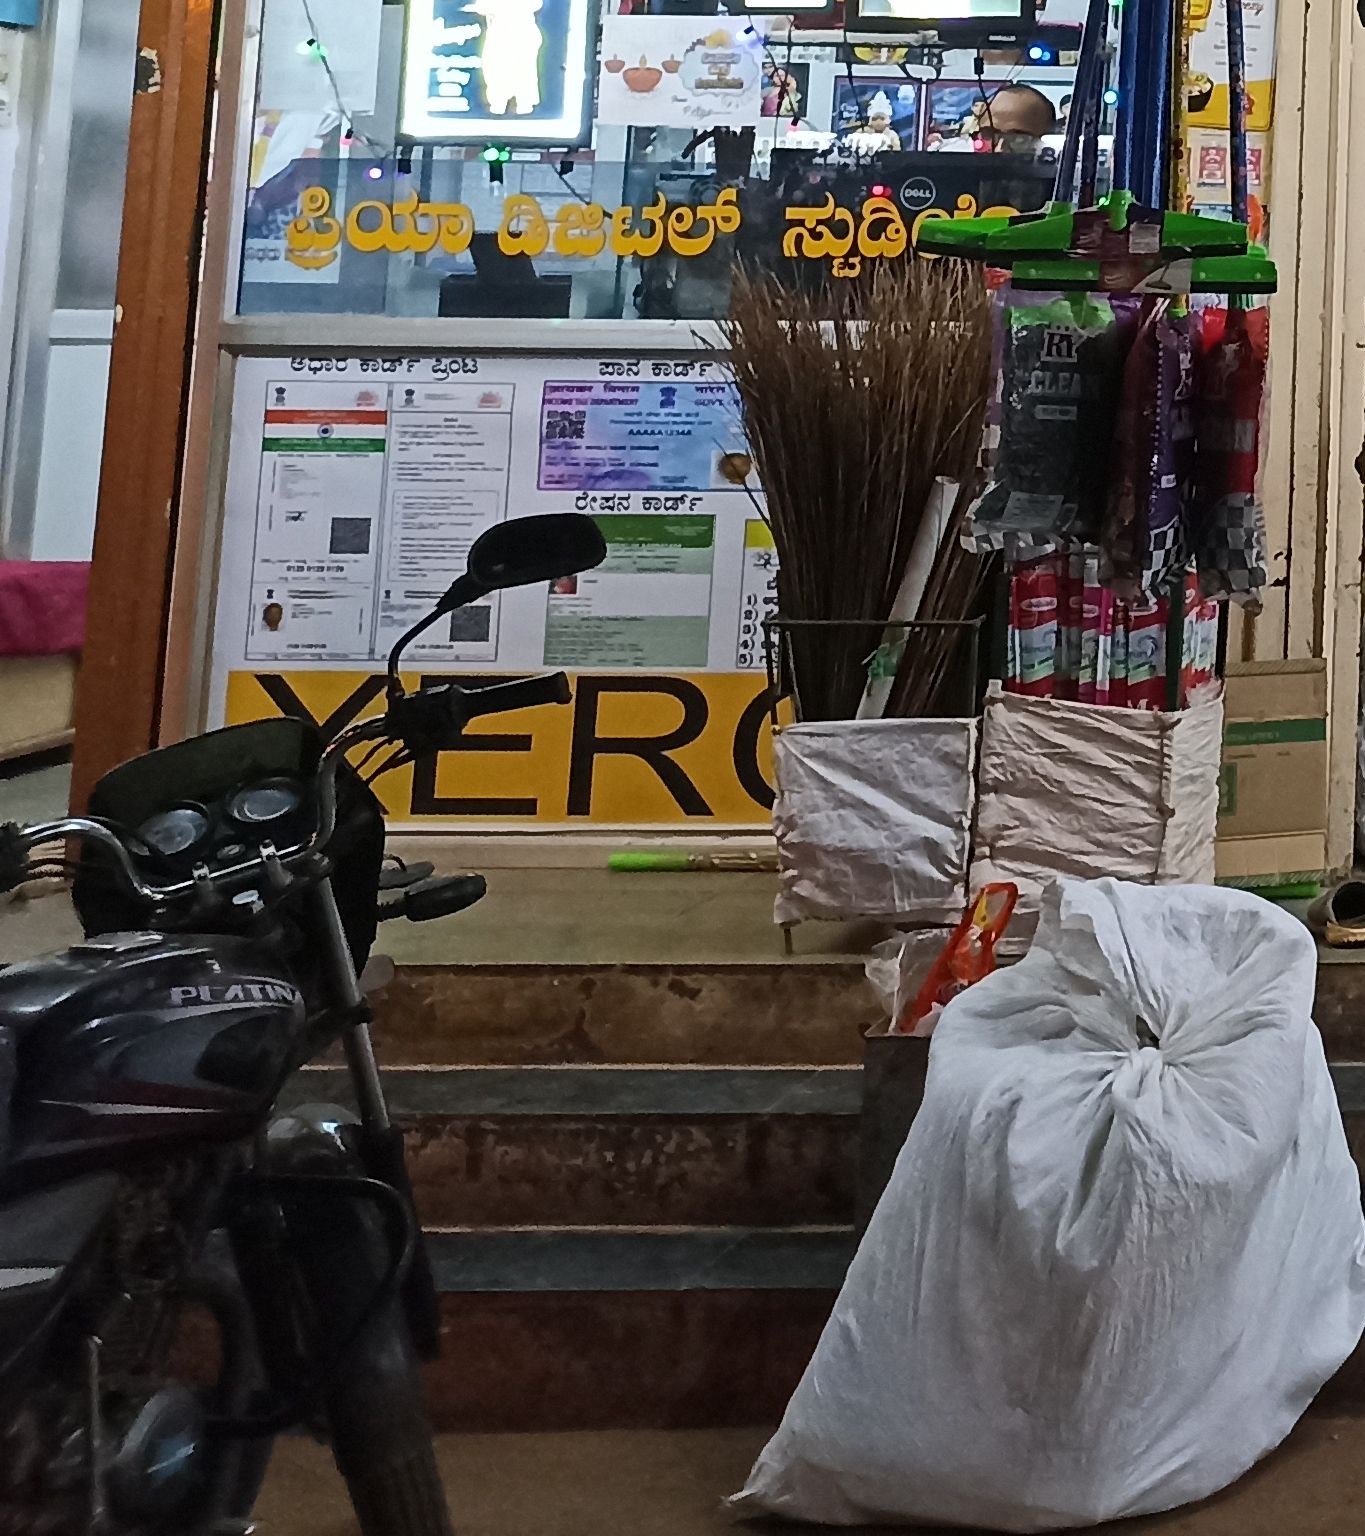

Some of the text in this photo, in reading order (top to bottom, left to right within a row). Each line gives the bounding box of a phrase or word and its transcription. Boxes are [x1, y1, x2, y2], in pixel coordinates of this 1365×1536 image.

[285, 186, 1021, 278] ಪ್ರಿಯಾ ಡಿಜಿಟಲ್ ಸ್ಟುಡಿ
[170, 984, 297, 1006] PLATIN
